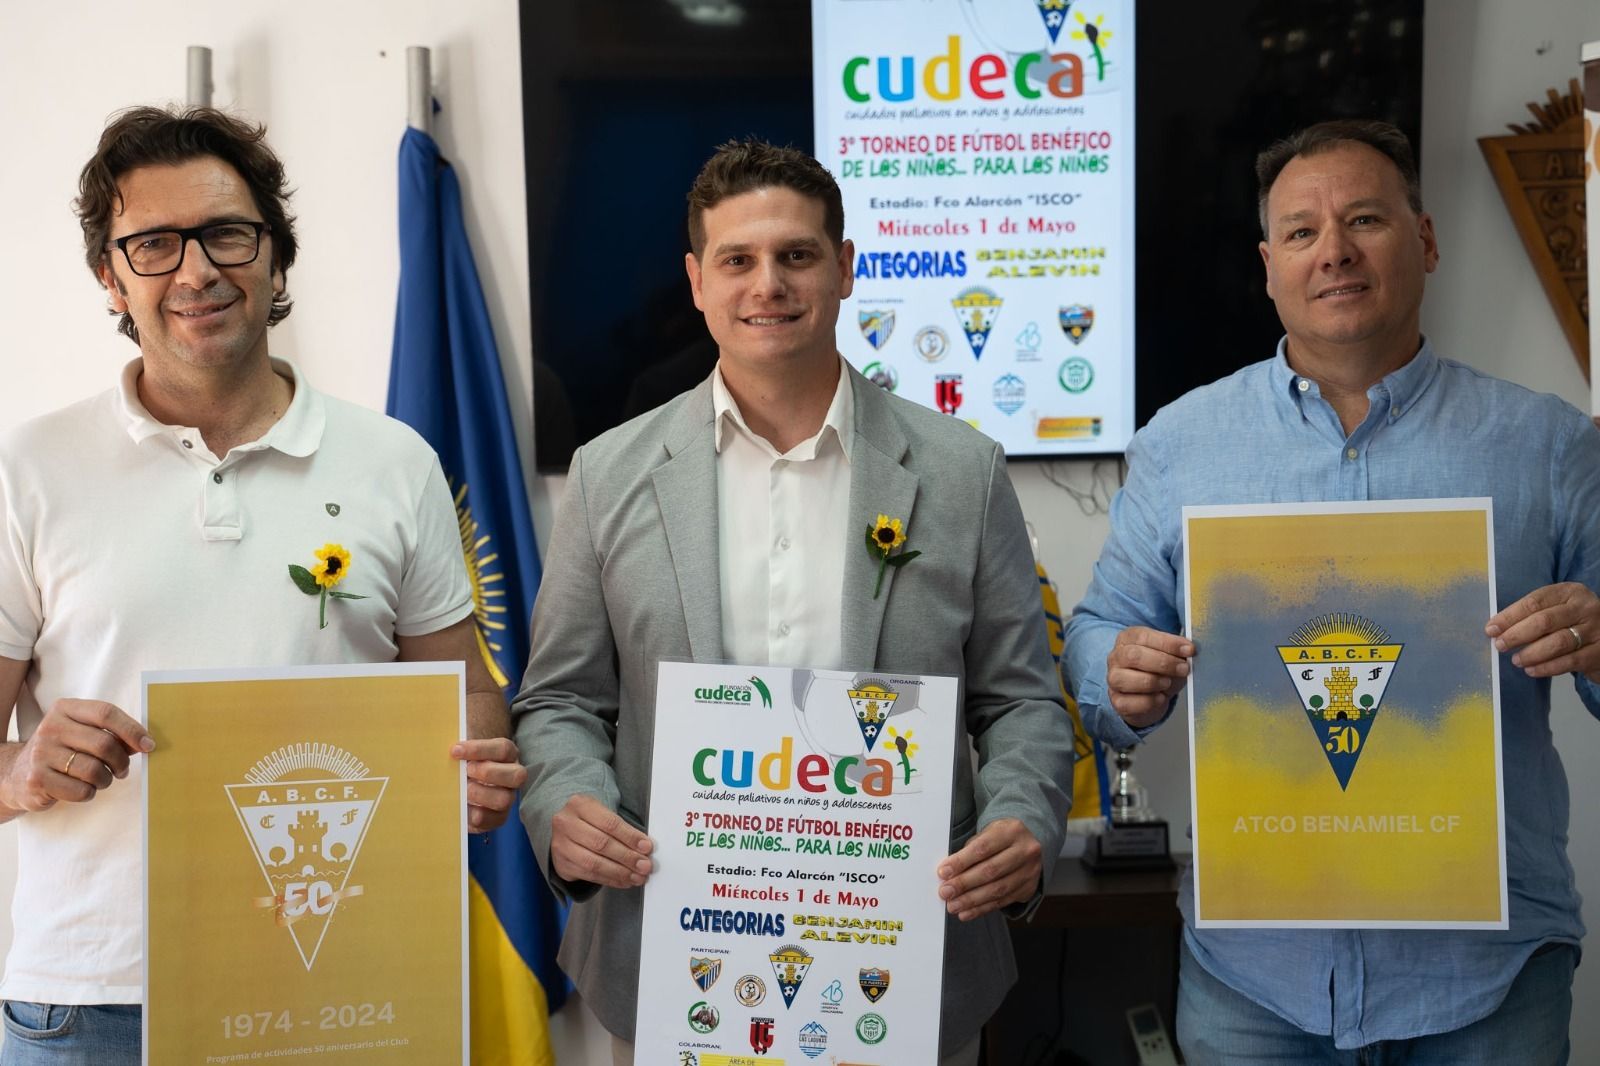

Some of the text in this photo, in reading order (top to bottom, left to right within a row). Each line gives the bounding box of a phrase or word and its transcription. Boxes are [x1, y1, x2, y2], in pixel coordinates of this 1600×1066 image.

[842, 35, 1084, 103] cudeca
[860, 136, 930, 154] TORNEO
[936, 134, 956, 152] DE
[962, 128, 1025, 152] FÚTBOL
[1031, 126, 1112, 150] BENÉFICO
[842, 159, 863, 178] DE
[973, 156, 1017, 175] PARA
[934, 196, 960, 208] Fco
[964, 195, 1022, 207] Alarcón
[855, 249, 967, 278] ATEGORIAS
[695, 685, 752, 702] cudeca
[1325, 726, 1360, 754] 50
[692, 736, 894, 797] cudeca
[692, 790, 893, 811] cuidados paliativos en niños y adolescentes
[702, 813, 762, 832] TORNEO
[765, 816, 784, 833] DE
[787, 814, 841, 837] FÚTBOL
[845, 818, 914, 842] BENÉFICO
[1233, 814, 1461, 833] ATCO BENAMIEL CF
[686, 831, 705, 847] DE
[709, 832, 736, 850] L@S
[795, 838, 832, 855] PARA
[836, 841, 863, 858] L@S
[867, 838, 911, 861] NIÑ@S
[707, 863, 756, 877] Estadio:
[761, 867, 783, 879] Fco
[786, 869, 835, 882] Alarcón
[797, 888, 804, 903] 1
[838, 891, 879, 910] Mayo
[680, 907, 904, 938] CATEGORIAS BENJAMIN
[799, 929, 898, 946] ALEVIN
[221, 1009, 294, 1039] 1974
[319, 1001, 395, 1031] 2024
[206, 1036, 409, 1064] Programa de actividades 50 aniversario del Club
